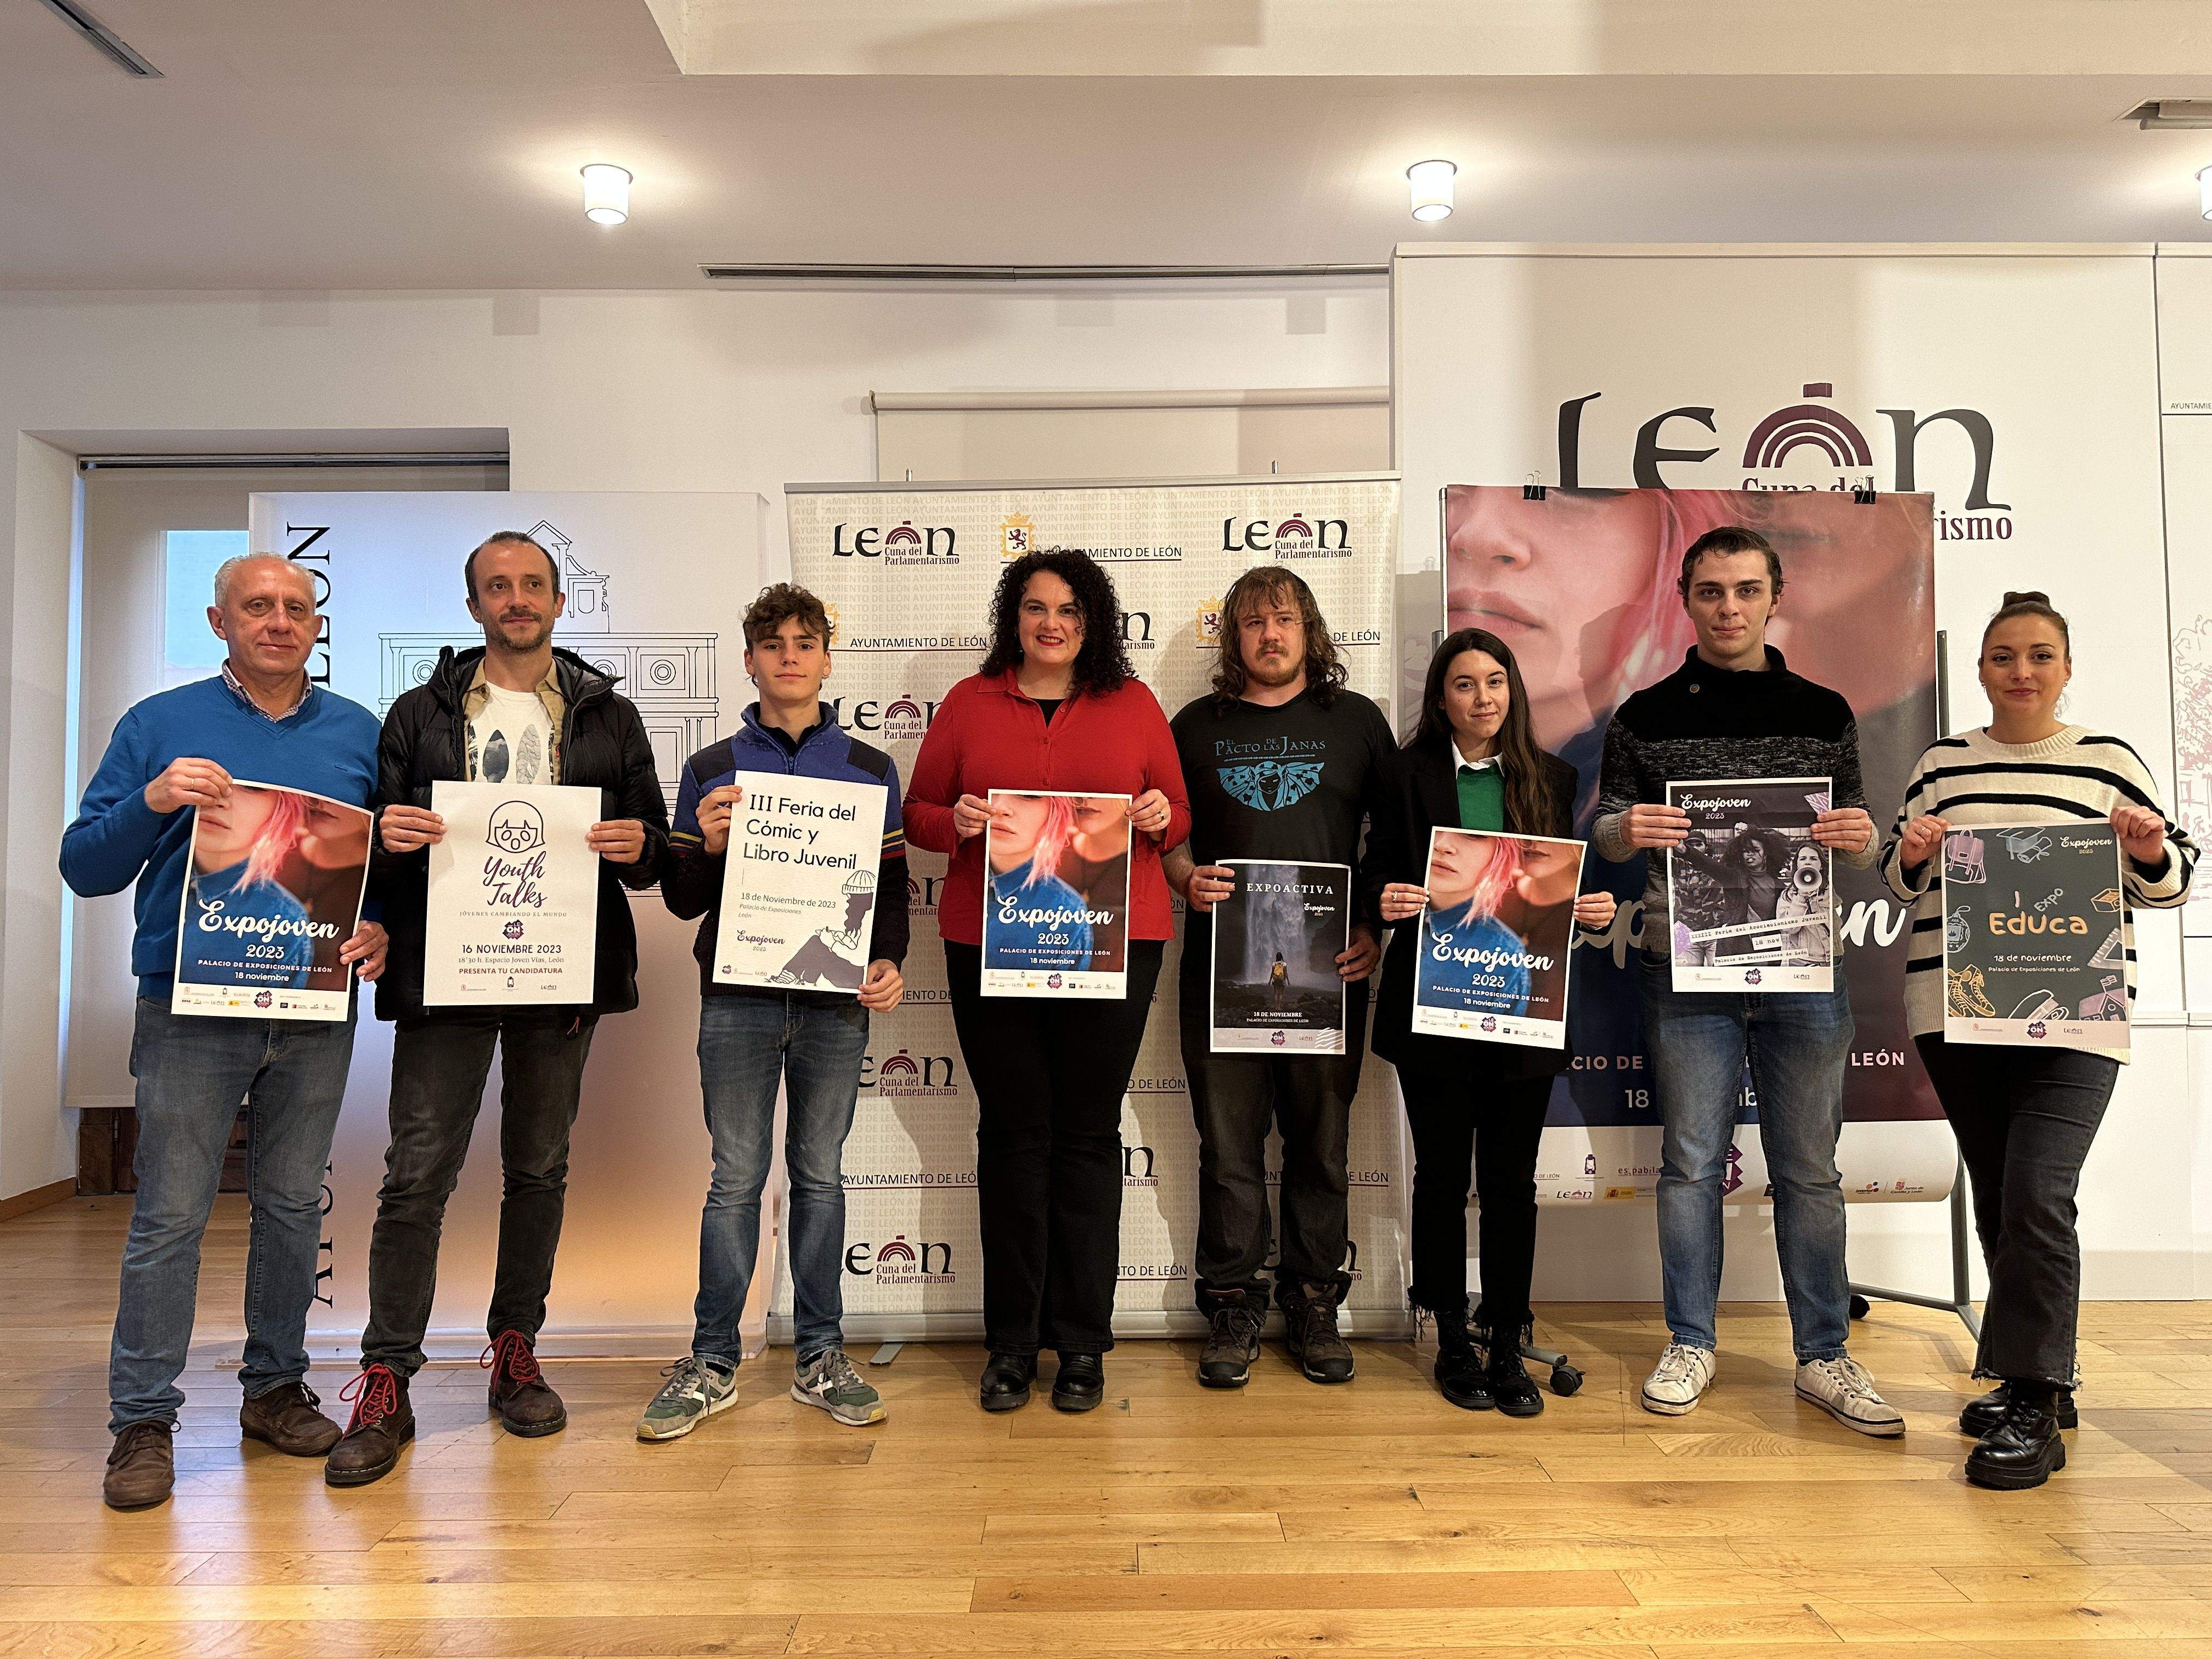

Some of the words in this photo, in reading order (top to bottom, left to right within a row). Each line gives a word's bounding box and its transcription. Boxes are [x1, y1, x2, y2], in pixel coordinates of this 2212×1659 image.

[884, 546, 907, 556] Cuna
[909, 546, 922, 556] del
[1136, 548, 1149, 557] DE
[1154, 545, 1182, 556] LEÓN
[1275, 540, 1297, 550] Cuna
[1300, 539, 1313, 549] del
[1275, 549, 1352, 559] Parlamentarismo
[884, 556, 960, 566] Parlamentarismo
[850, 637, 938, 648] AYUNTAMIENTO
[941, 637, 955, 647] DE
[958, 634, 986, 647] LEÓN
[1333, 633, 1348, 642] DE
[1351, 629, 1380, 641] LEÓN
[884, 721, 906, 730] Cuna
[909, 720, 922, 729] del
[884, 730, 926, 740] Parlamen
[749, 794, 773, 812] III
[778, 798, 824, 818] Feria
[829, 804, 856, 821] del
[1680, 794, 1751, 812] Expojoven
[746, 819, 802, 840] Cómic
[808, 830, 819, 845] y
[2060, 836, 2113, 849] Expojoven
[743, 843, 789, 862] Libro
[793, 849, 857, 870] Juvenil
[483, 851, 546, 886] Youth
[487, 881, 548, 908] Talks
[1246, 883, 1333, 894] EXPOACTIVA
[752, 893, 761, 901] de
[763, 895, 805, 906] Noviembre
[807, 899, 816, 907] de
[818, 900, 837, 909] 2023
[2033, 888, 2064, 912] EXPO
[768, 906, 802, 915] Exposiciones
[997, 895, 1114, 931] Expojoven
[1304, 902, 1335, 912] Expojoven
[199, 899, 340, 943] Expojoven
[1989, 911, 2088, 935] Educa
[737, 930, 786, 945] Expojoven
[1037, 933, 1069, 945] 2023
[245, 944, 285, 959] 2023
[462, 945, 472, 953] 16
[477, 945, 533, 953] NOVIEMBRE
[537, 945, 561, 953] 2023
[1432, 932, 1554, 973] Expojoven
[2021, 953, 2072, 962] noviembre
[245, 962, 300, 971] EXPOSICIONES
[245, 973, 289, 981] noviembre
[1472, 973, 1505, 988] 2023
[1472, 990, 1520, 1000] EXPOSICIONES
[1472, 998, 1511, 1009] noviembre
[1616, 1056, 1643, 1070] DE
[1851, 1048, 1905, 1066] LEÓN
[879, 1077, 903, 1087] Cuna
[905, 1076, 919, 1086] del
[1138, 1079, 1153, 1089] DE
[1156, 1076, 1186, 1089] LEÓN
[879, 1087, 958, 1097] Parlamentarismo
[1625, 1090, 1649, 1108] 18
[843, 1173, 933, 1184] AYUNTAMIENTO
[938, 1173, 952, 1183] DE
[956, 1170, 977, 1183] LEÓ
[1359, 1169, 1389, 1182] LEÓN
[876, 1264, 899, 1274] Cuna
[902, 1263, 916, 1273] del
[1139, 1266, 1154, 1276] DE
[1158, 1262, 1188, 1276] LEÓN
[876, 1274, 956, 1284] Parlamentarismo
